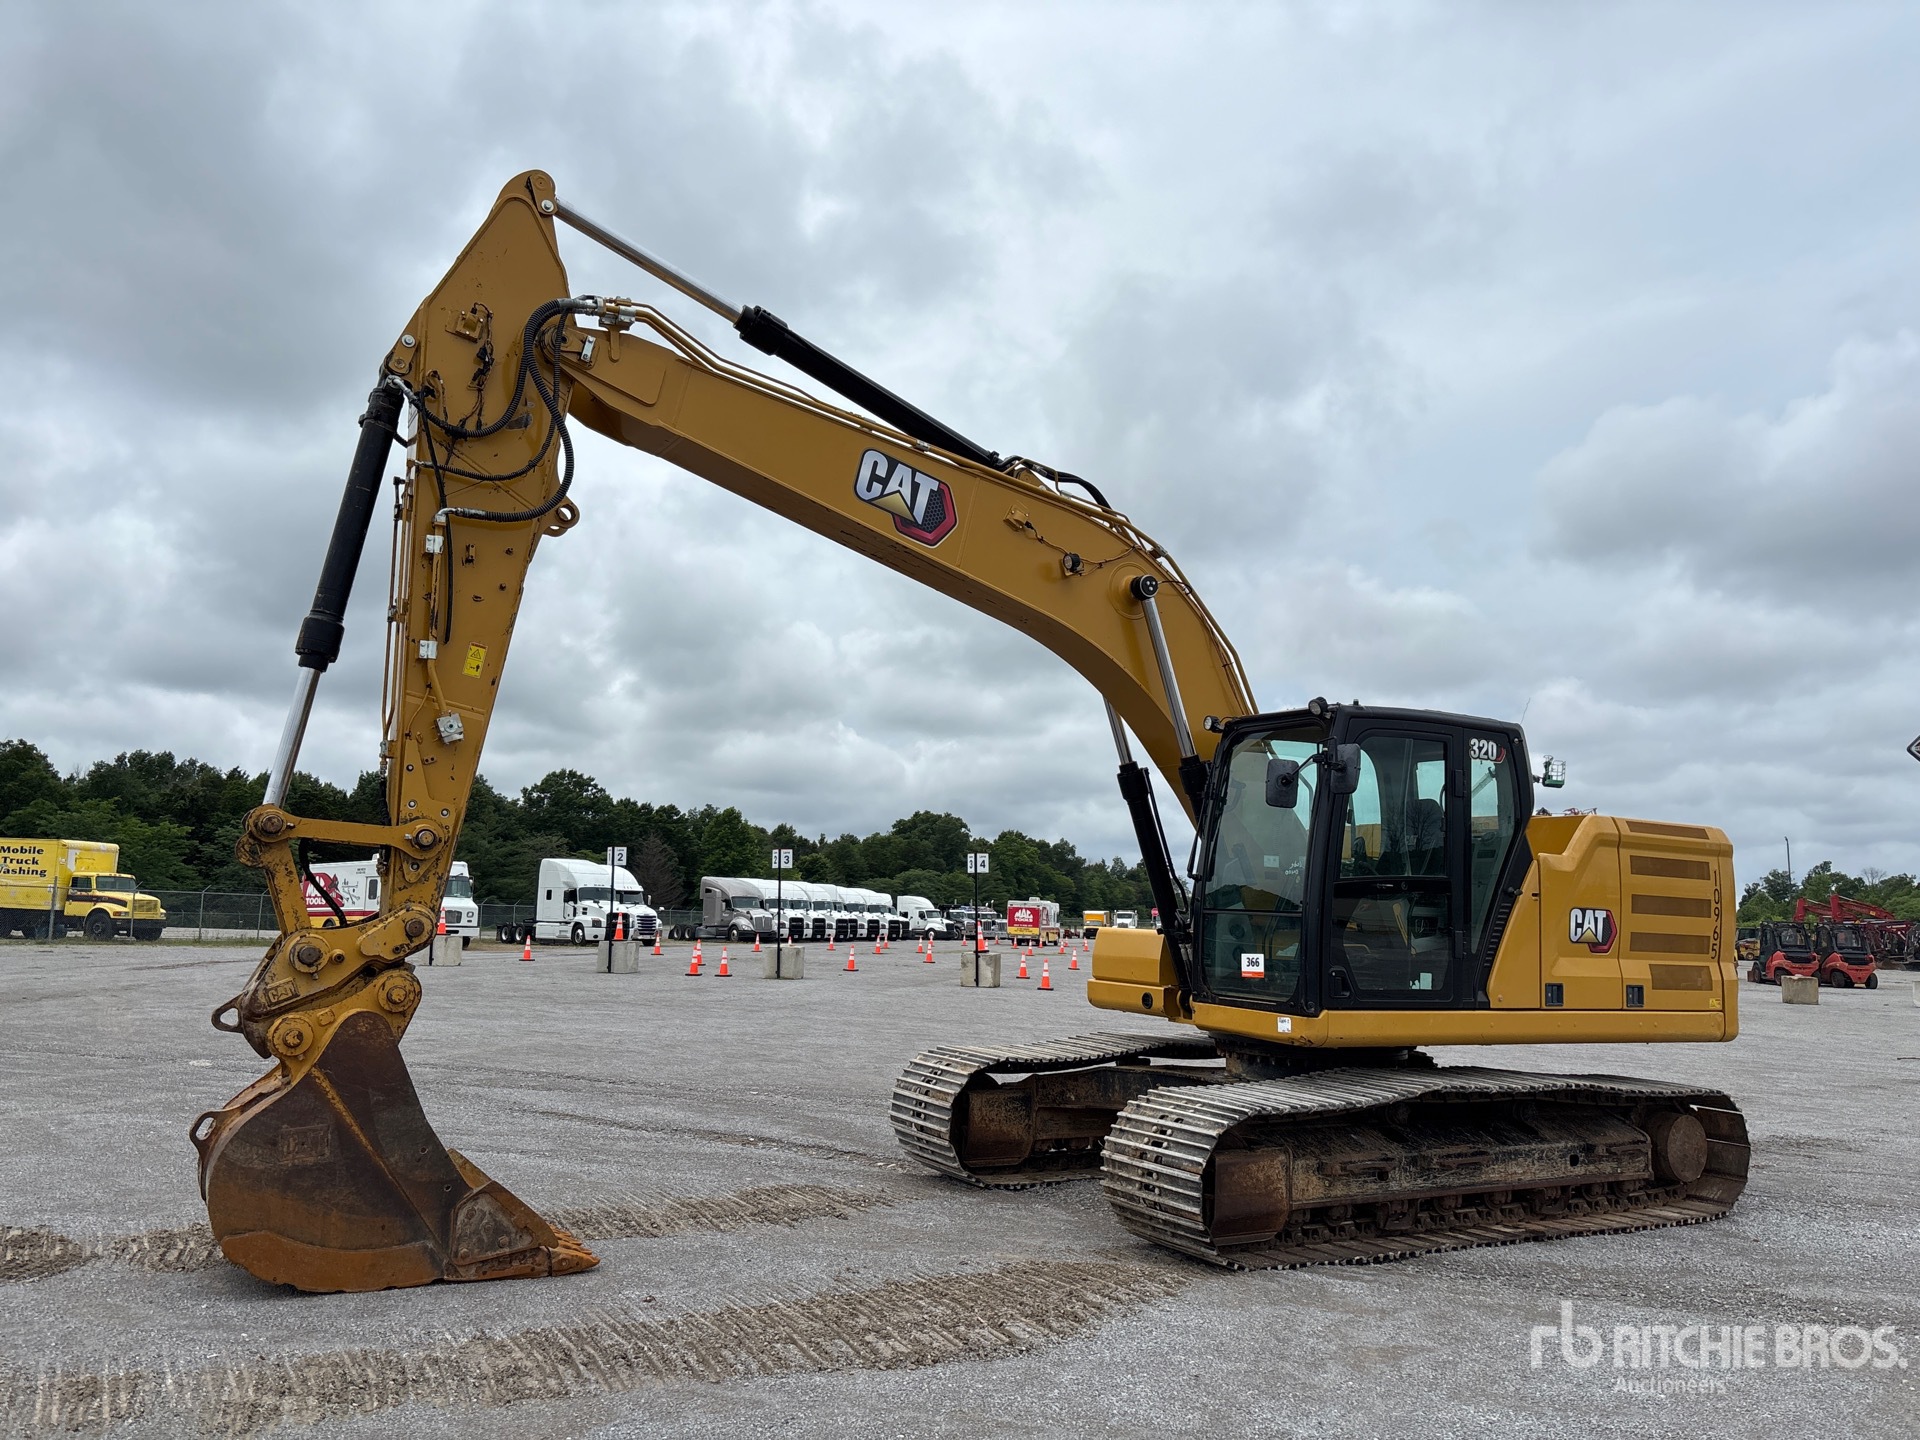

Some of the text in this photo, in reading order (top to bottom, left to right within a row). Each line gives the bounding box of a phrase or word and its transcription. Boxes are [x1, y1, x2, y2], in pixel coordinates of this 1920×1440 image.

[856, 450, 940, 525] CAT
[1470, 738, 1497, 760] 320
[0, 846, 44, 855] Mobile
[2, 856, 39, 865] Truck
[617, 852, 624, 861] 2
[784, 855, 790, 864] 3
[980, 860, 986, 868] 4
[0, 866, 47, 878] ashing
[305, 897, 327, 905] TOOLS
[1711, 870, 1720, 960] 10965
[1570, 908, 1607, 943] CAT
[1246, 957, 1260, 967] 366
